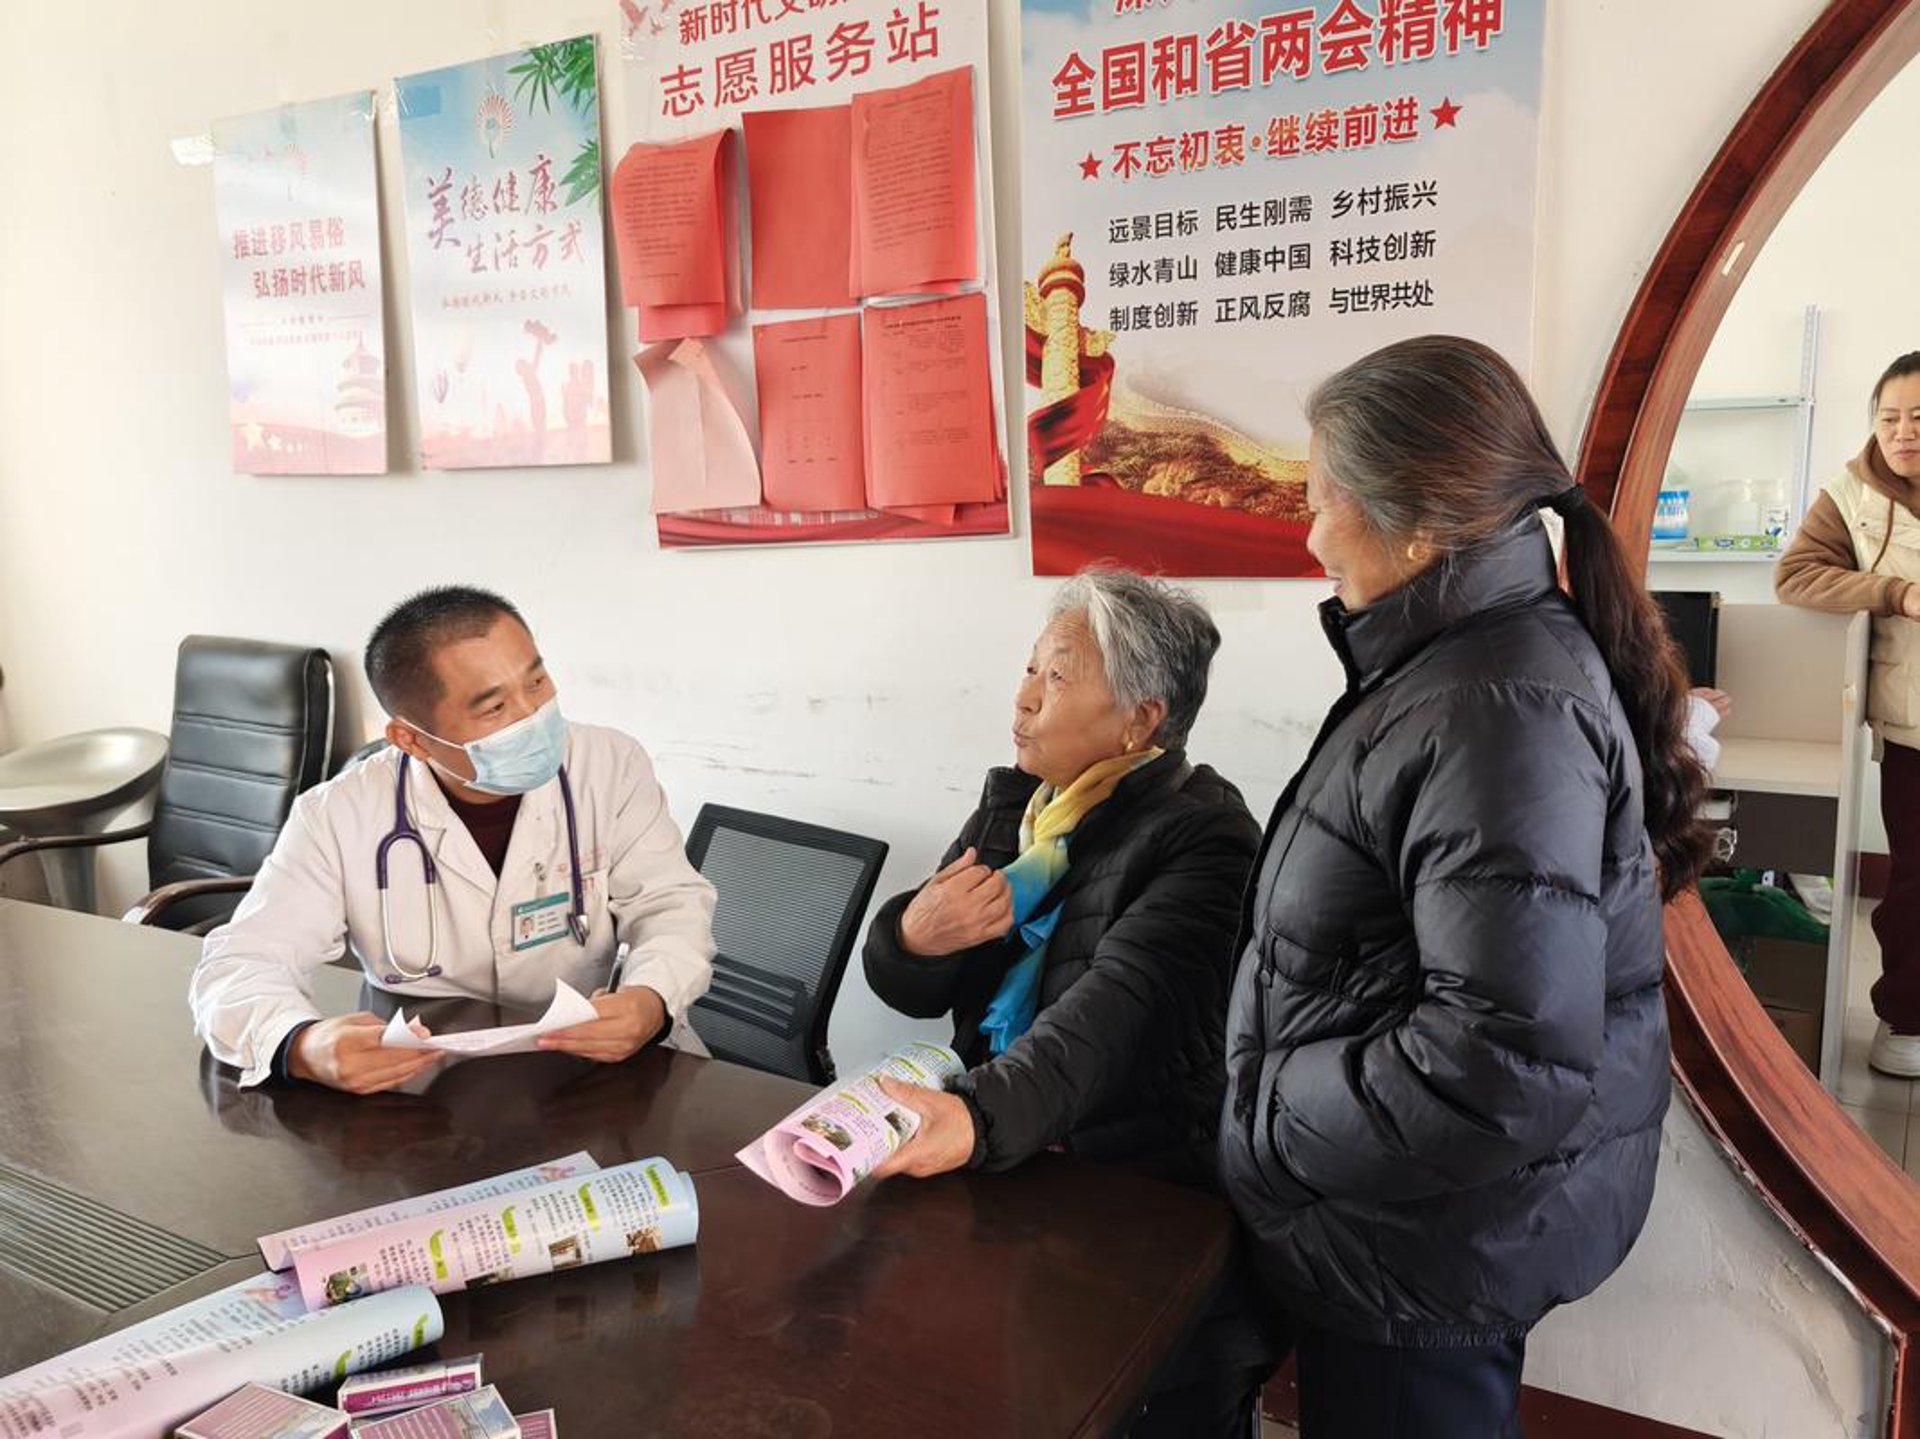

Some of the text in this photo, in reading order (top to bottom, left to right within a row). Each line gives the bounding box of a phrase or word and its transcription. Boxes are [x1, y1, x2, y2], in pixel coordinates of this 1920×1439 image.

[660, 1, 939, 117] 志愿服务站
[1052, 0, 1503, 117] 全国和省两会精神
[1112, 96, 1419, 179] 不忘初衷·继续前进
[427, 154, 559, 250] 美德健康
[1109, 180, 1438, 244] 远景目标 民生刚需 乡村振兴
[234, 216, 345, 259] 推进移风易俗
[467, 219, 585, 273] 生活方式
[1109, 229, 1437, 288] 绿水青山 健康中国 科技创新
[253, 260, 366, 299] 弘扬时代新风
[1109, 278, 1434, 332] 制度创新 正风反腐 与世界共处
